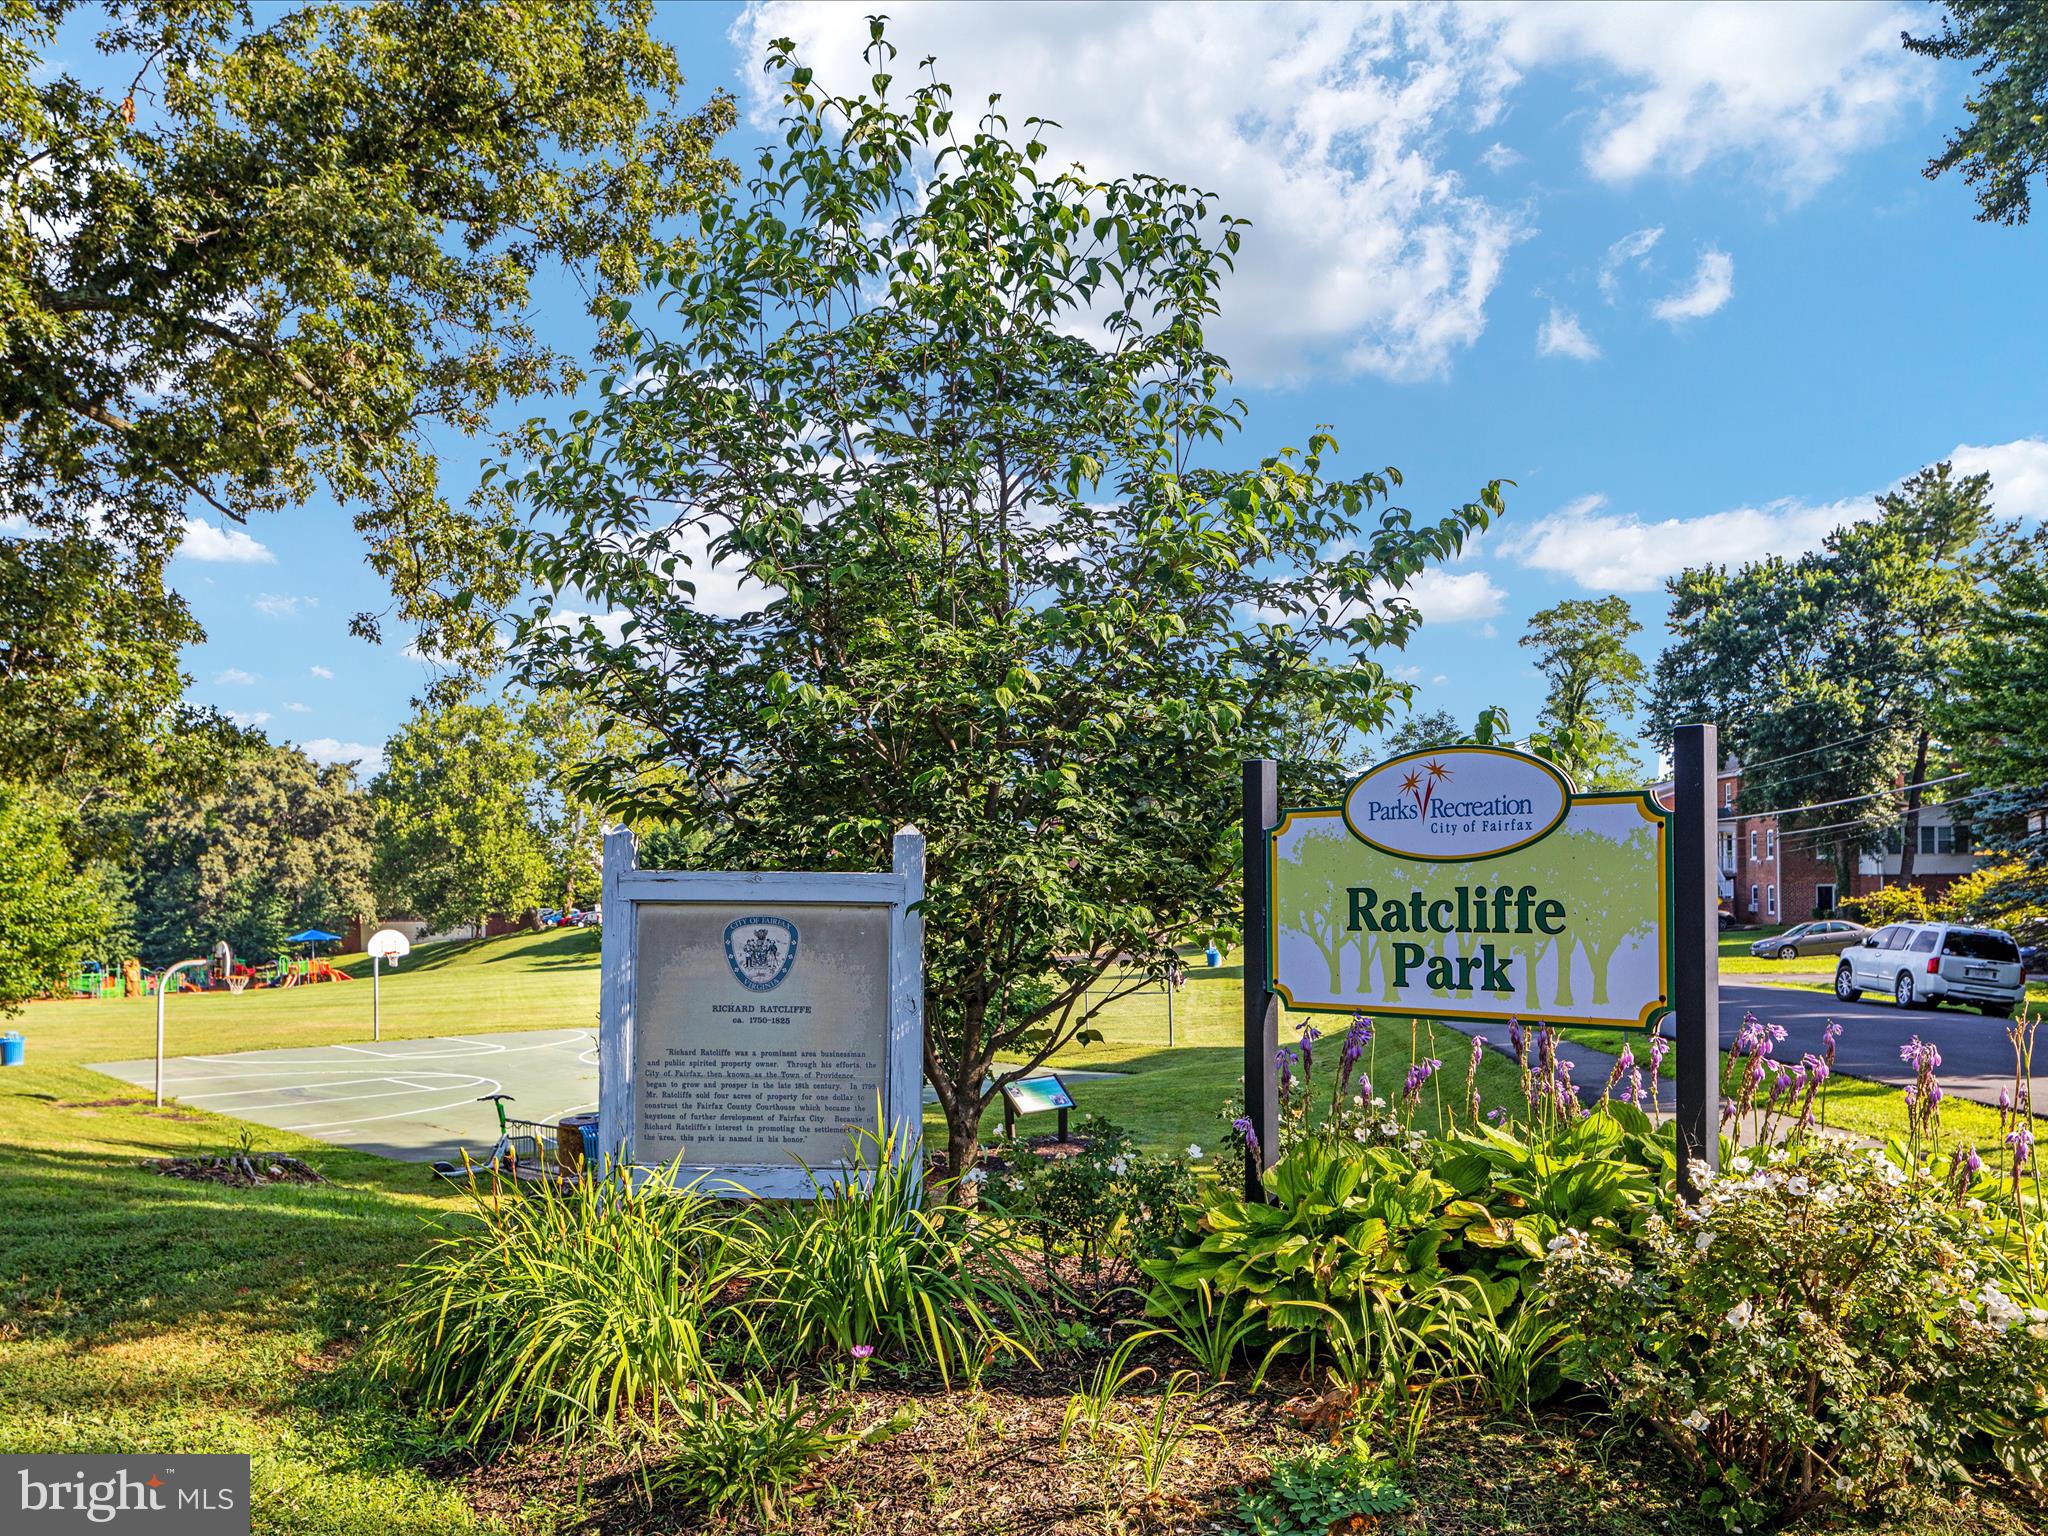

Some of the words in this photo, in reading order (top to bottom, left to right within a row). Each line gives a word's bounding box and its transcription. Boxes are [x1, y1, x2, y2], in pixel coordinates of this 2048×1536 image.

[1368, 799, 1418, 821] Parks
[1430, 794, 1533, 818] Recreation
[1431, 822, 1457, 836] City
[1463, 821, 1476, 832] of
[1482, 820, 1532, 832] Fairfax
[1346, 885, 1566, 935] Ratcliffe
[730, 918, 747, 930] CITY
[762, 917, 791, 930] FAIRFAX
[1392, 942, 1515, 992] Park
[744, 979, 780, 990] VIRGINIA
[760, 1005, 811, 1014] RATCLIFFE
[700, 1048, 730, 1056] Ratcliffe
[761, 1050, 797, 1058] prominent
[665, 1059, 685, 1068] public
[689, 1060, 716, 1068] spirited
[721, 1060, 751, 1068] property
[787, 1061, 817, 1069] Through
[645, 1070, 659, 1078] City
[813, 1083, 842, 1091] century.
[727, 1103, 752, 1111] County
[720, 1114, 764, 1122] development
[810, 1115, 826, 1123] City.
[758, 1125, 795, 1133] promoting
[698, 1134, 714, 1143] park
